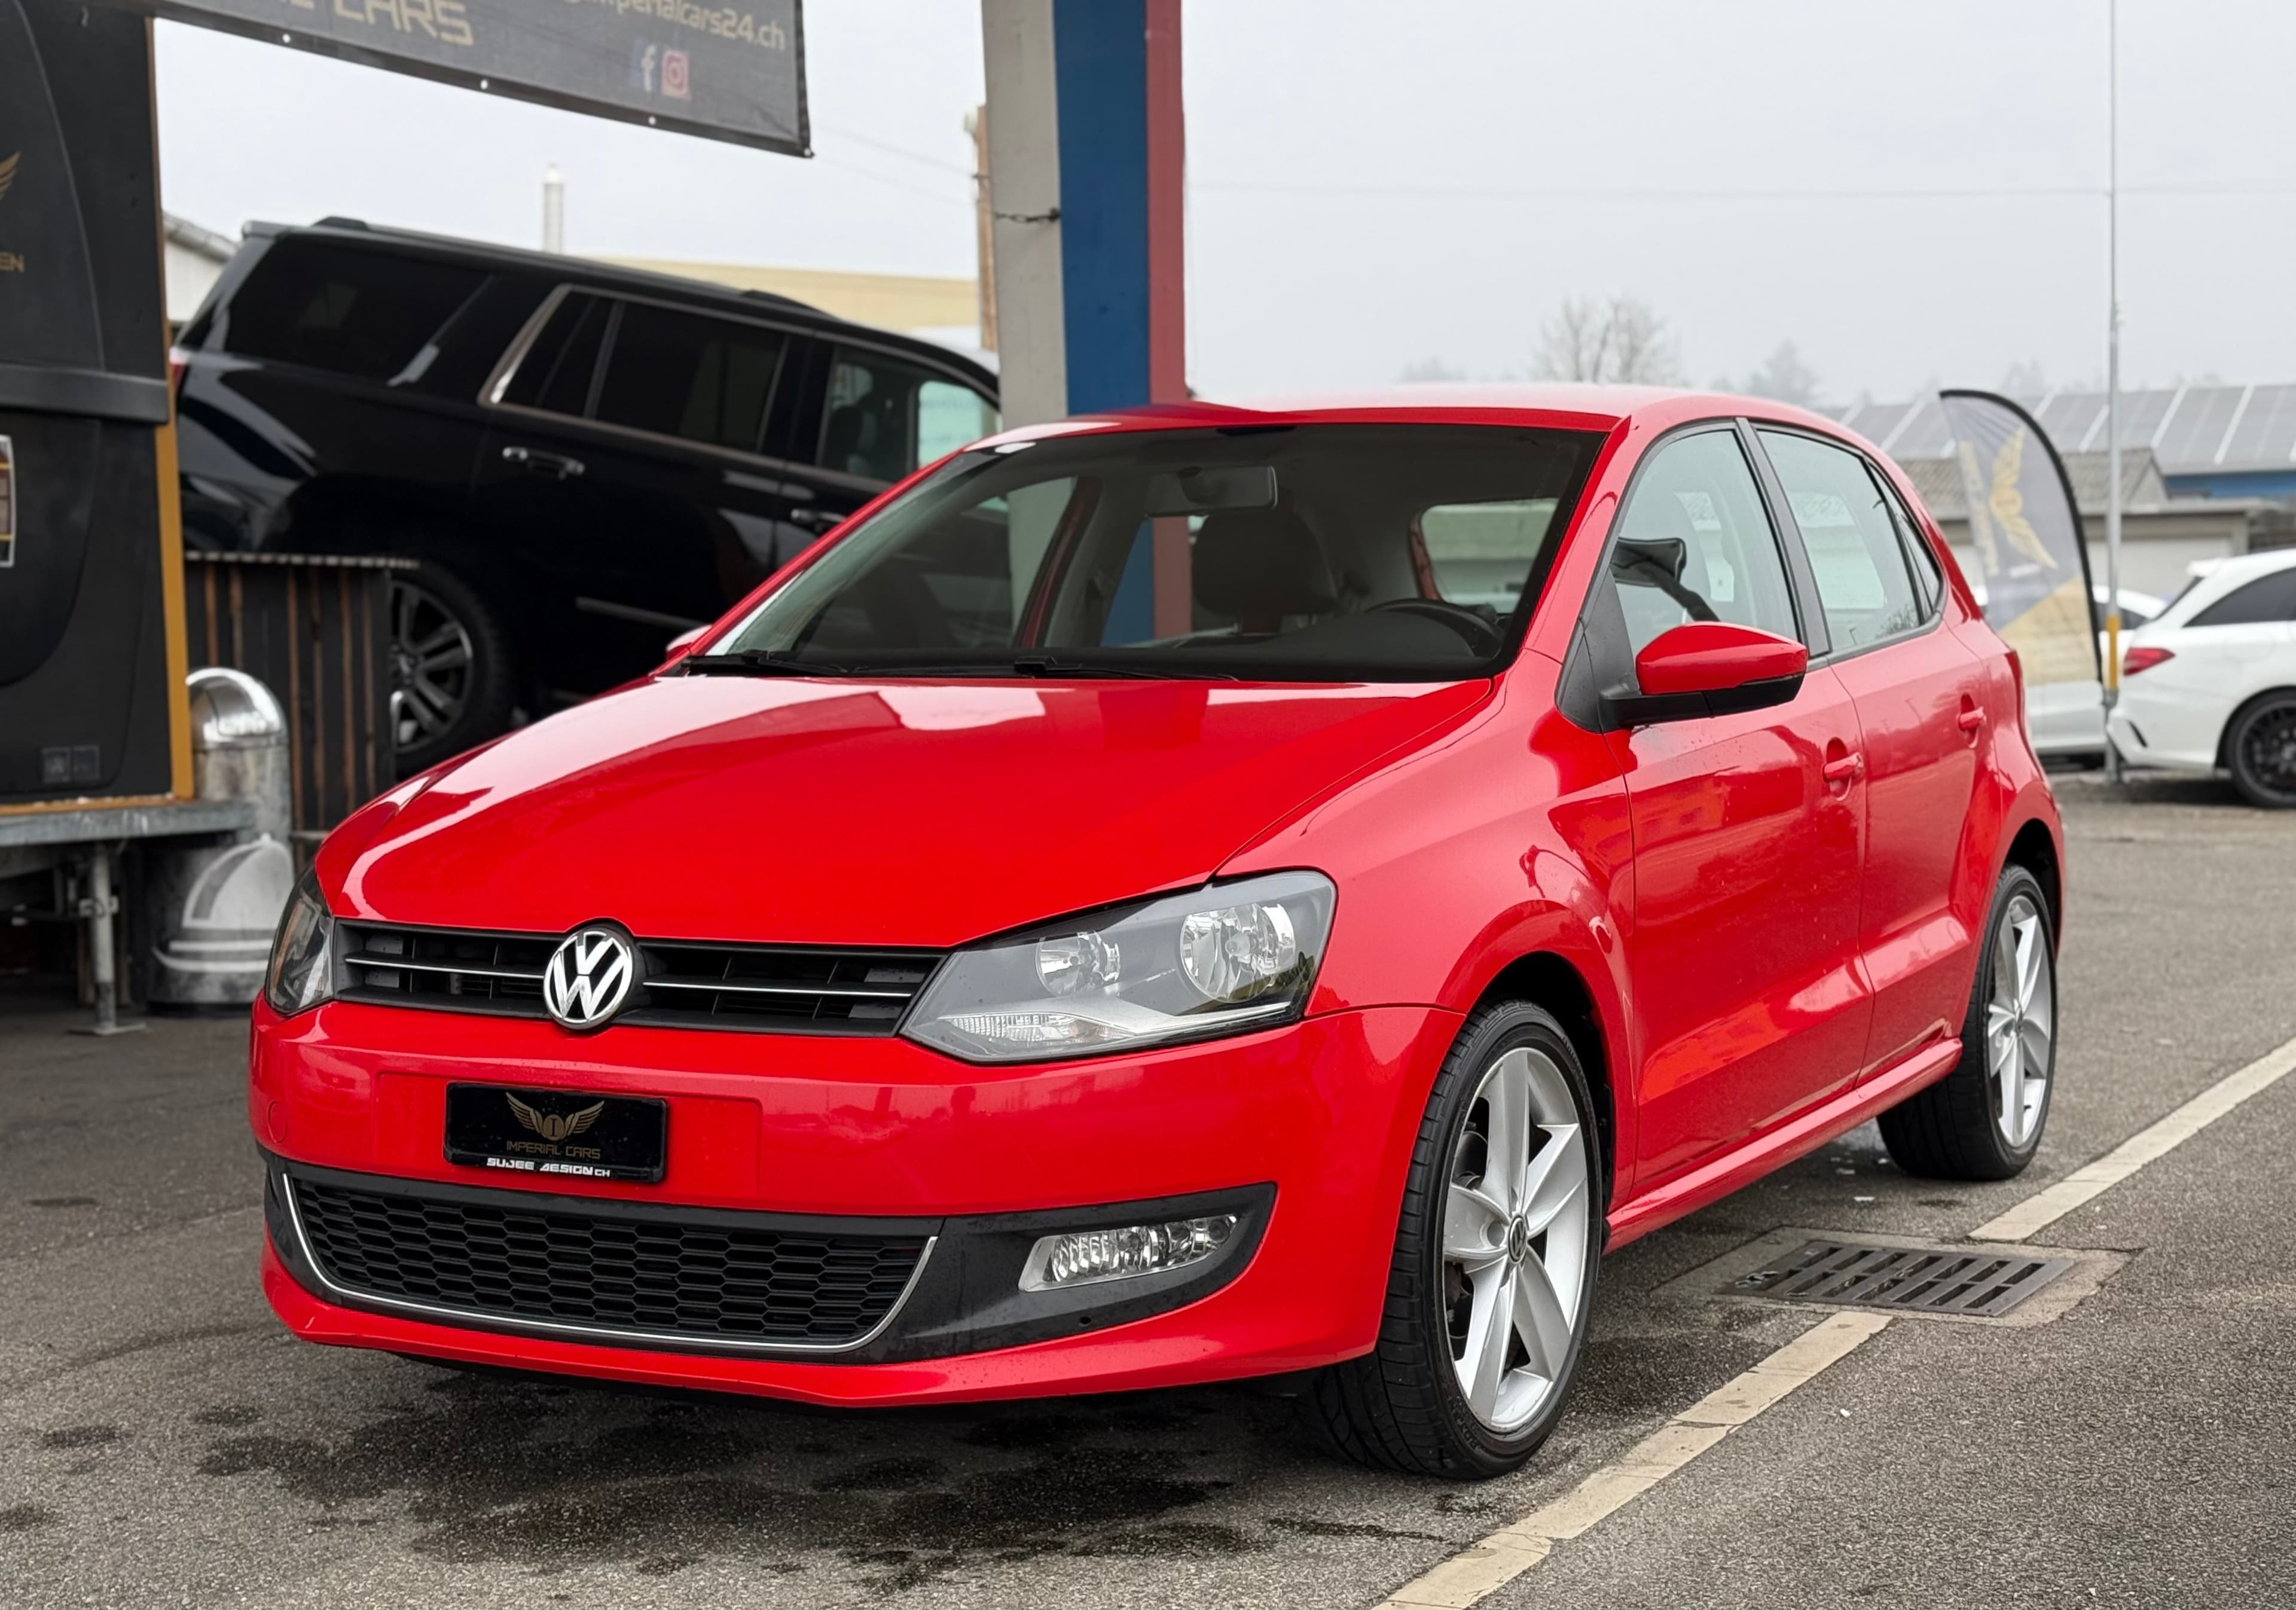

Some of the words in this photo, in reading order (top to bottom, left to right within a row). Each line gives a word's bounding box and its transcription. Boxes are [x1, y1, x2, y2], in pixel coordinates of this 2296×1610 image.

[564, 0, 786, 51] perialcars24.ch
[506, 1141, 561, 1155] IMPERIAL
[565, 1146, 601, 1159] CARS
[487, 1157, 535, 1170] SUJEE
